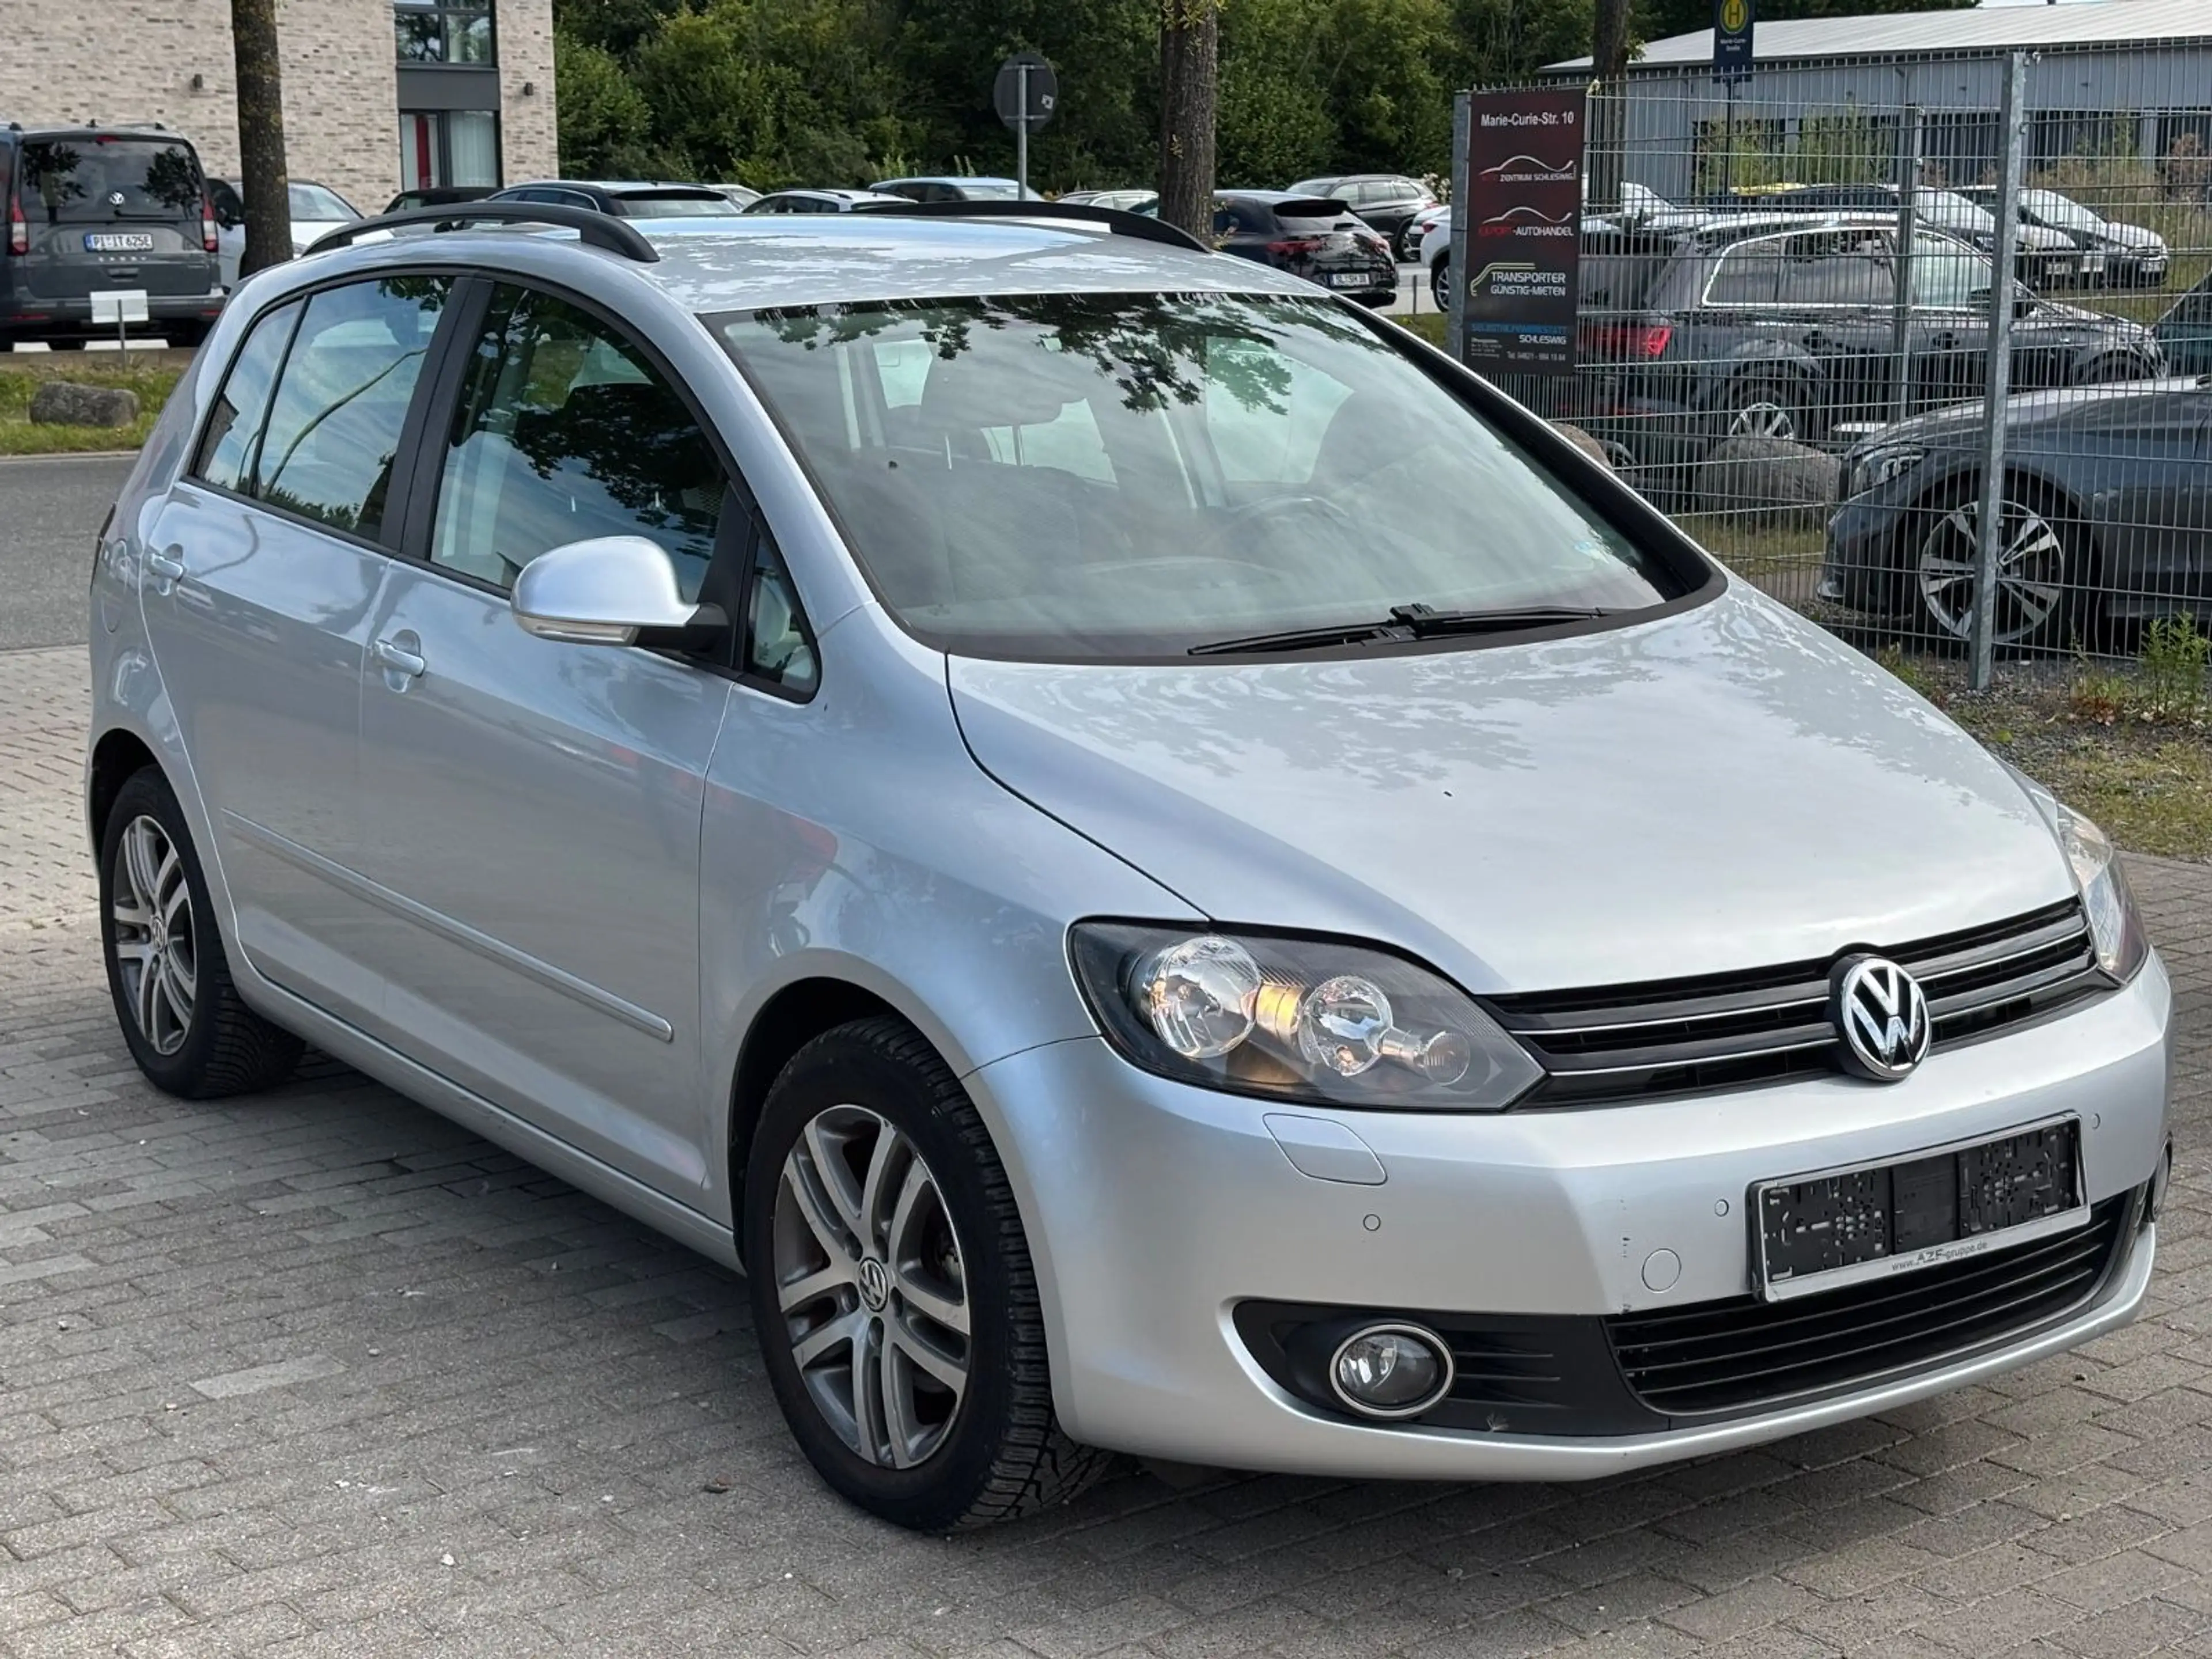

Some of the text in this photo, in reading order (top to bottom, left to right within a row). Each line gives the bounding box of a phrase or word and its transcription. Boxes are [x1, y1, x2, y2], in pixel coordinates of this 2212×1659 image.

[1480, 111, 1574, 126] Marie-Curie-Str. 10
[1491, 272, 1566, 283] TRANSPORTER
